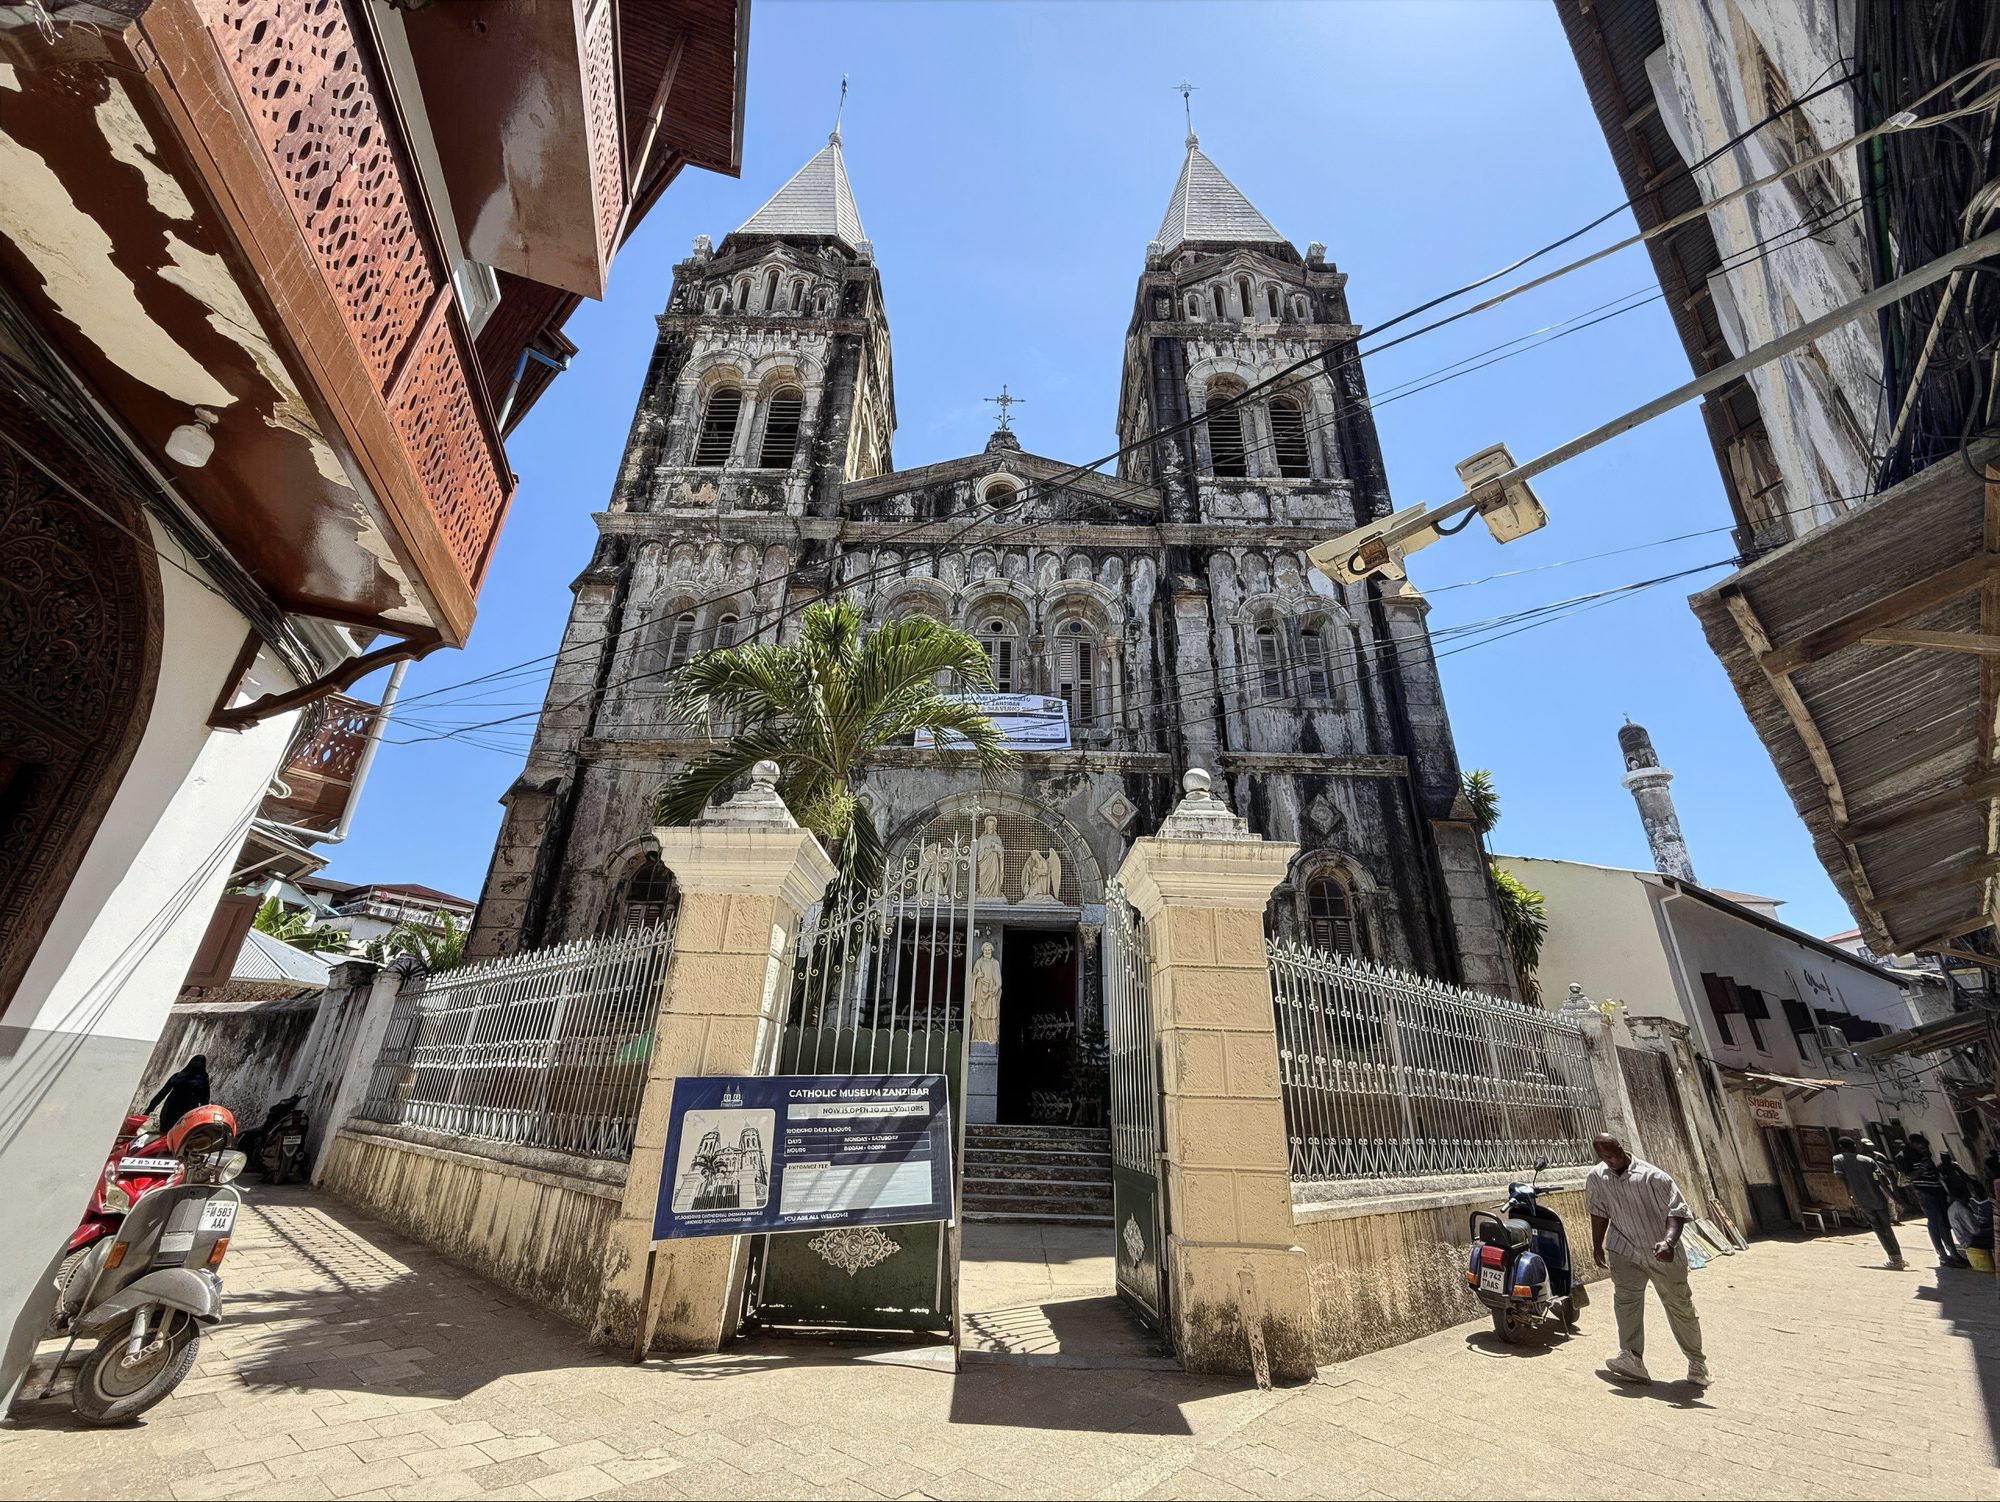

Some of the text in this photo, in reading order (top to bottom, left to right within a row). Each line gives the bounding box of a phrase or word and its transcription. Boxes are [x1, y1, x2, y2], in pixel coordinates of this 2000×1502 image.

[789, 1088, 930, 1098] CATHOLIC MUSEUM ZANZIBAR
[1748, 1097, 1784, 1109] Shabani
